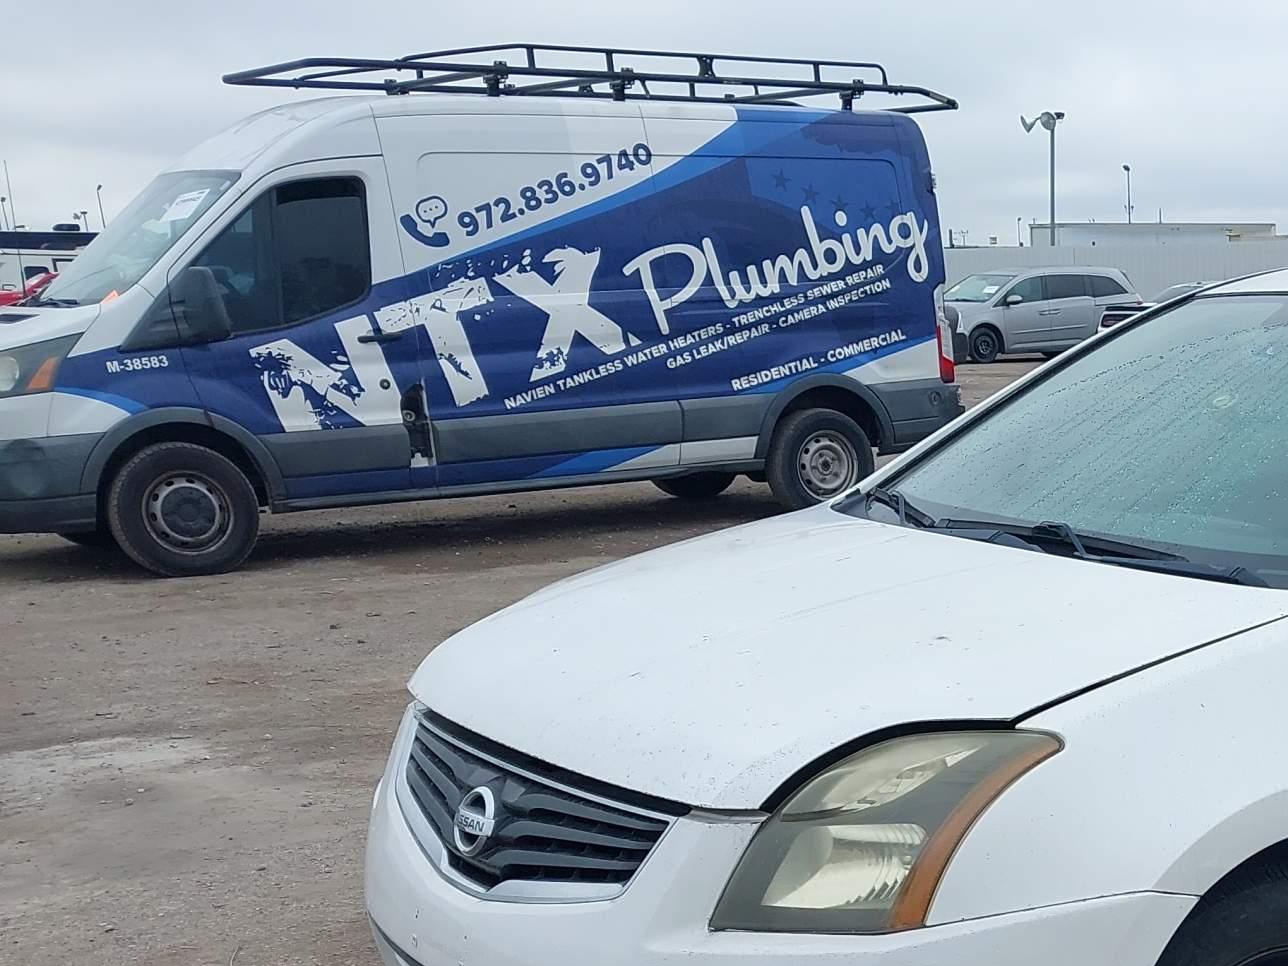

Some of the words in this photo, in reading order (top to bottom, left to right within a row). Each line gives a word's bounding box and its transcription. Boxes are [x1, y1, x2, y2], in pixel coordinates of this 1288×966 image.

[457, 143, 652, 236] 972.836.9740
[622, 205, 929, 336] Plumbing
[106, 355, 169, 374] M-38583
[249, 247, 627, 433] NTX
[504, 383, 555, 410] NAVIEN
[557, 359, 624, 392] TANKLESS
[624, 344, 667, 368] WATER
[668, 323, 724, 353] HEATERS
[732, 293, 805, 327] TRENCHLESS
[807, 280, 846, 301] SEWER
[846, 264, 885, 286] REPAIR
[666, 354, 692, 370] GAS
[693, 323, 770, 360] LEAK/REPAIR
[778, 306, 827, 328] CAMERA
[827, 278, 892, 310] INSPECTION
[731, 357, 818, 391] RESIDENTIAL
[826, 329, 906, 363] COMMERCIAL
